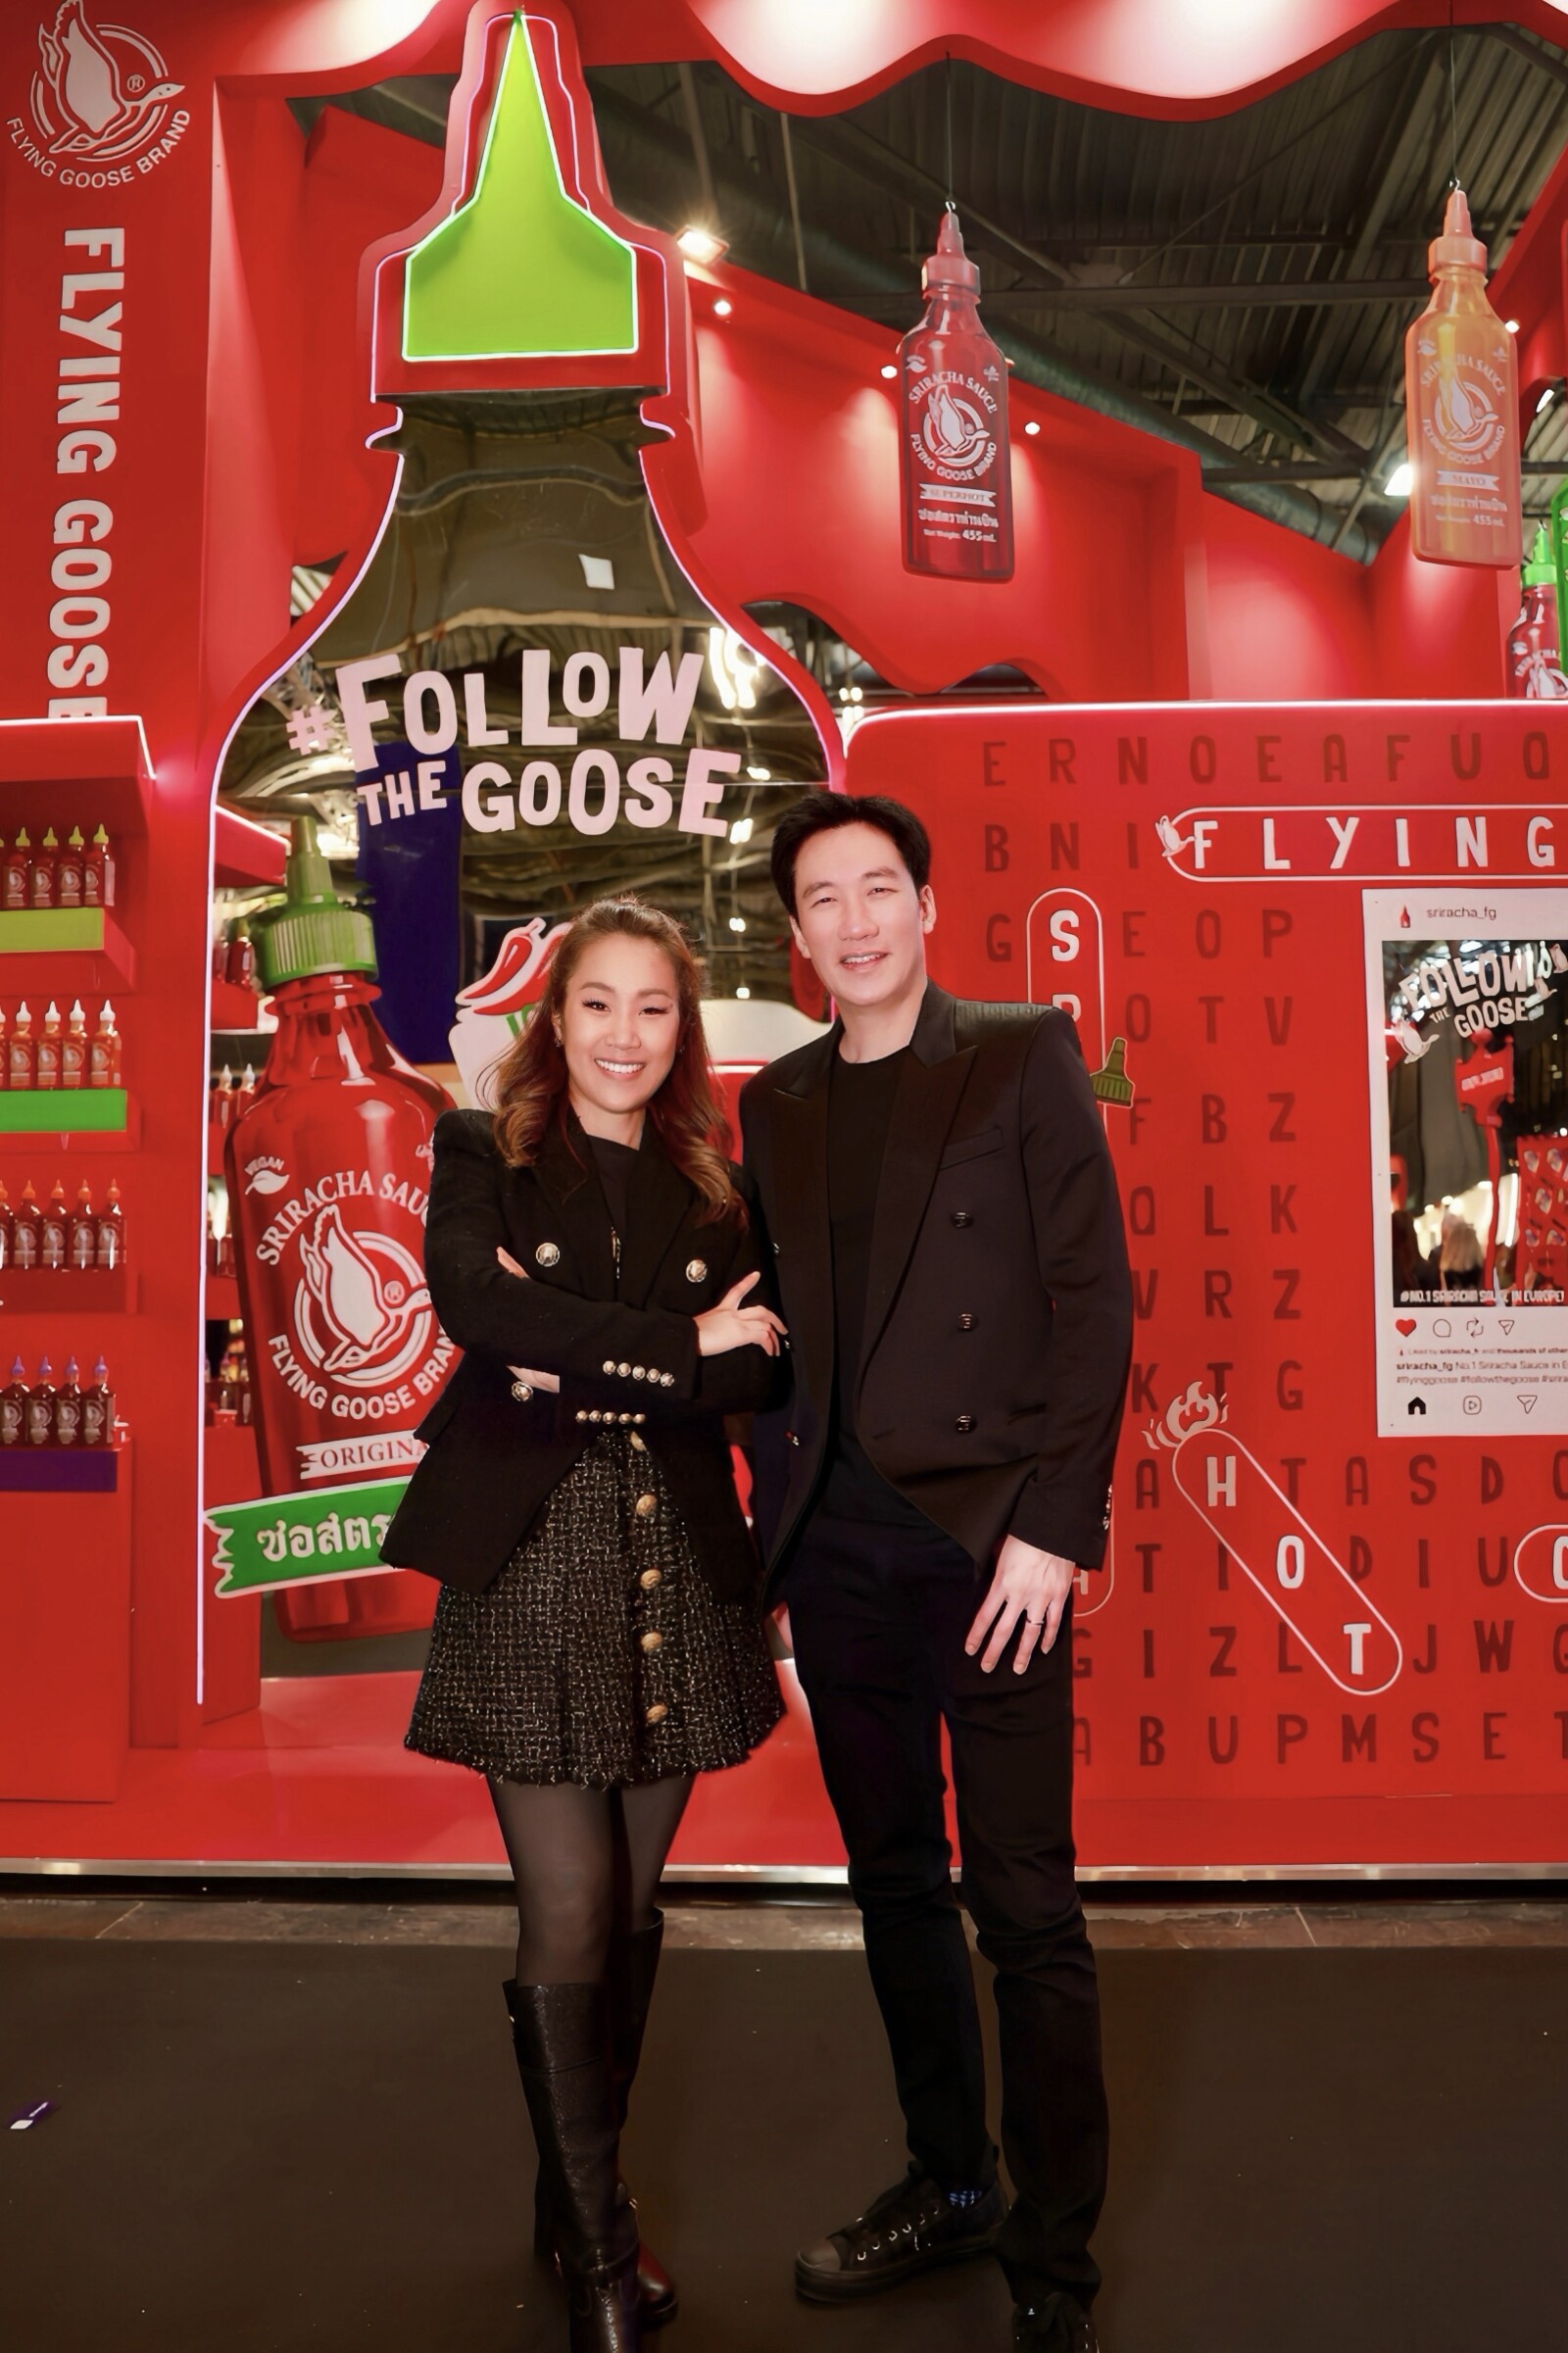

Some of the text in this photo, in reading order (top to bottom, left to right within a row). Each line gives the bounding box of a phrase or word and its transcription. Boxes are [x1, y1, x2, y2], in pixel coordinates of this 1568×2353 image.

[7, 110, 190, 189] FLYING GOOSE BRAND
[57, 226, 125, 474] FLYING
[356, 748, 742, 837] THE GOOSE
[1426, 906, 1497, 921] sriracha_fg
[1453, 996, 1530, 1039] GOOSE
[244, 1155, 285, 1176] VEGAN
[256, 1170, 430, 1266] SRIRACHA SAU
[268, 1334, 328, 1410] FLYING
[331, 1384, 416, 1420] GOOSE
